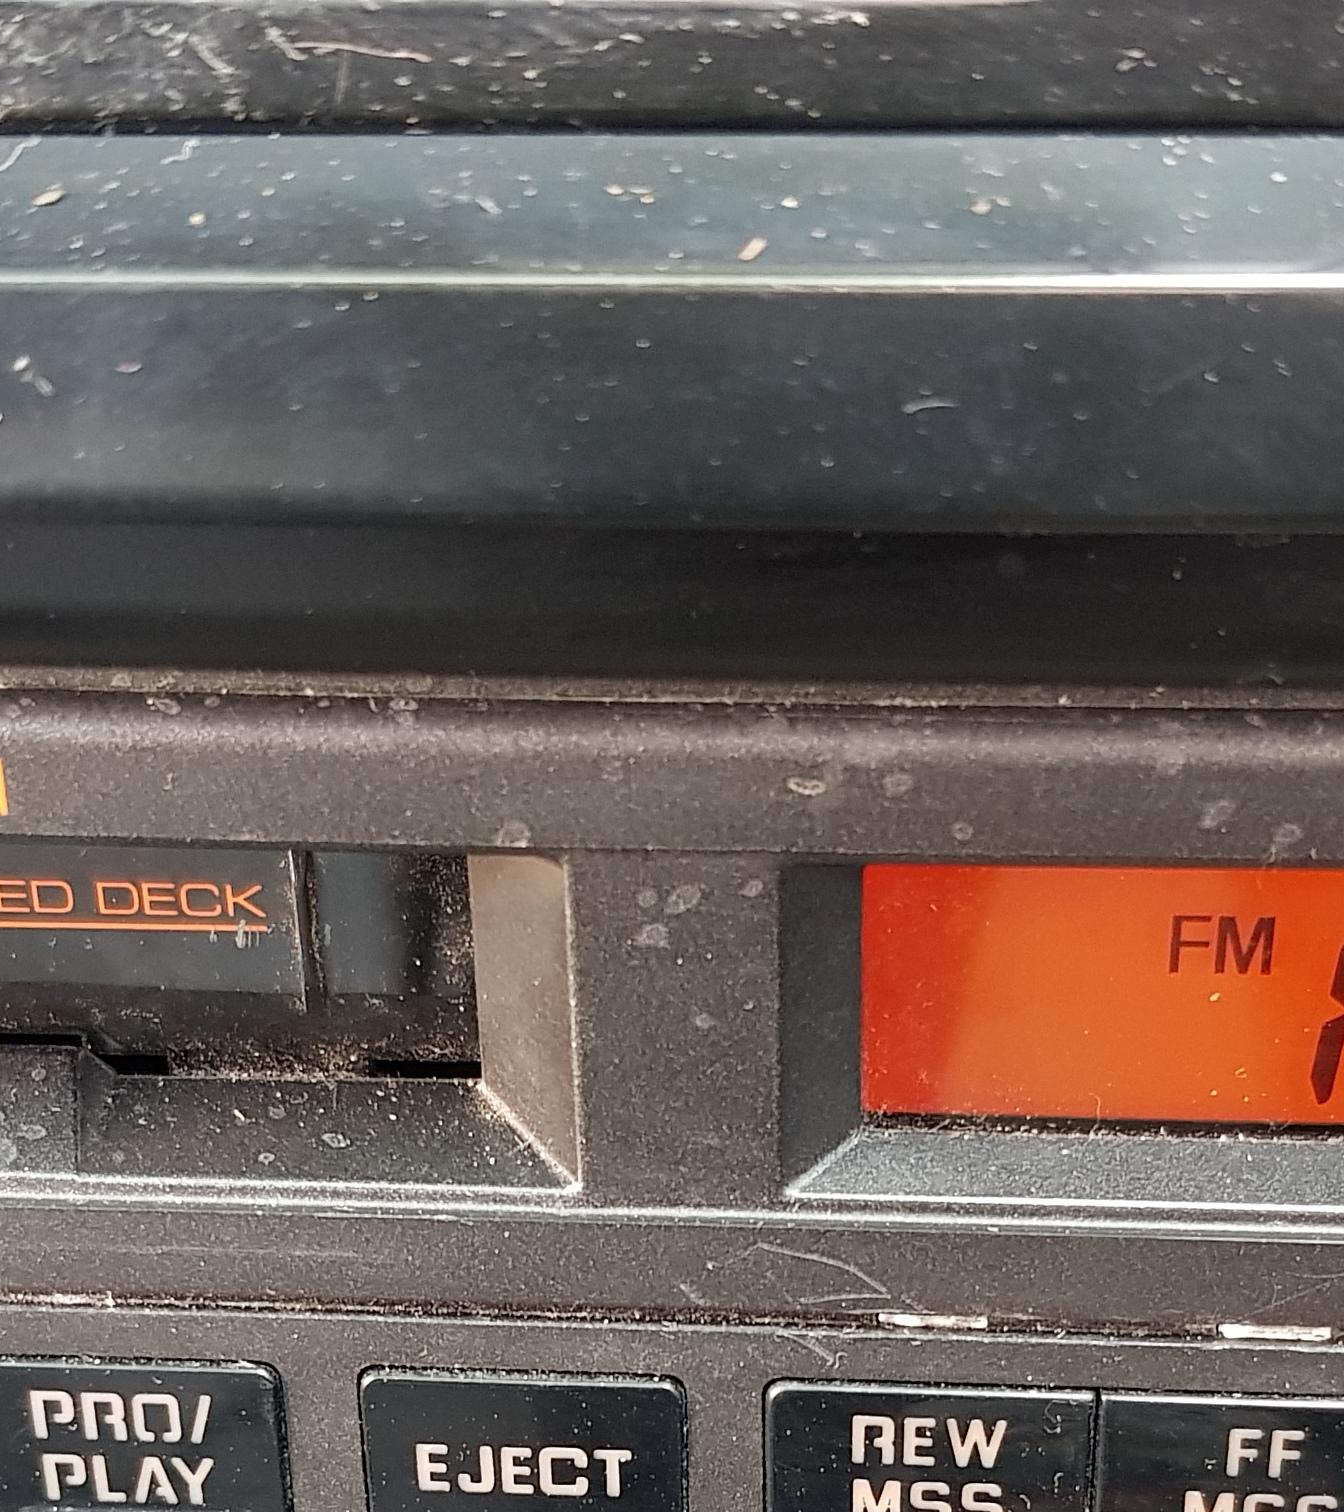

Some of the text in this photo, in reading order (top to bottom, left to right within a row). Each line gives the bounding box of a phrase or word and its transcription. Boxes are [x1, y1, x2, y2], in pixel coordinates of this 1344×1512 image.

[94, 880, 268, 920] DECK
[1166, 914, 1276, 976] FM
[850, 1416, 1008, 1470] REW
[1224, 1426, 1306, 1478] FF
[42, 1452, 216, 1506] PLAY
[415, 1445, 633, 1498] EJECT
